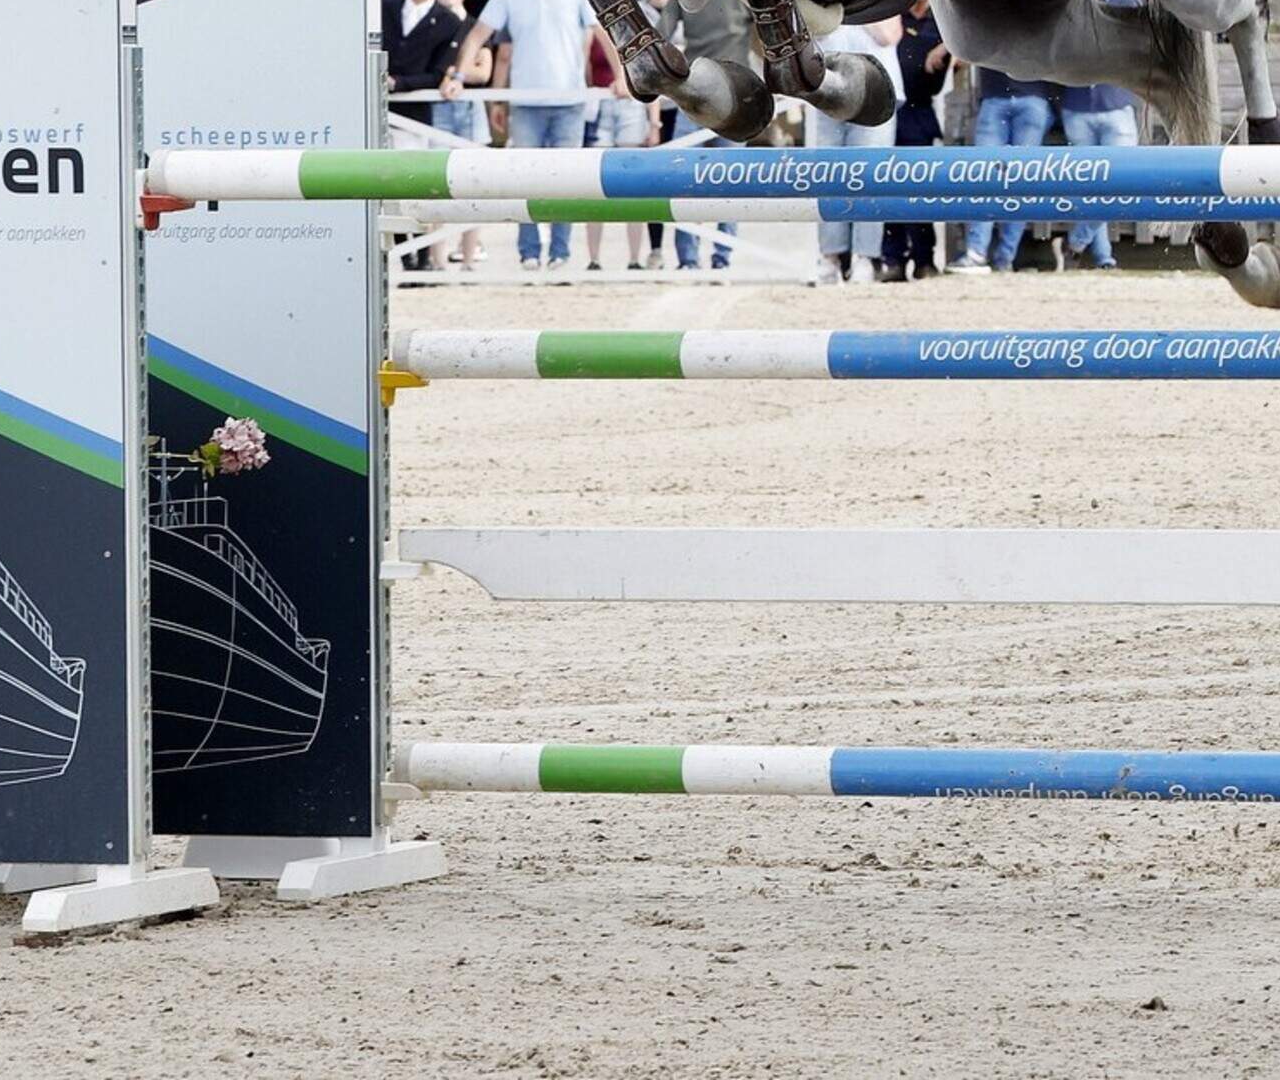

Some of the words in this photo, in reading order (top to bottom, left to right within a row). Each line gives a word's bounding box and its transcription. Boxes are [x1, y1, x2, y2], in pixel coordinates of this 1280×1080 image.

[161, 126, 332, 149] scheepswerf
[693, 155, 868, 191] vooruitgang
[873, 152, 941, 185] door
[949, 151, 1110, 190] aanpakken
[7, 225, 86, 244] aanpakken
[220, 223, 252, 239] door
[256, 224, 333, 241] aanpakken
[920, 335, 1084, 368] vooruitgang
[1093, 332, 1159, 361] door
